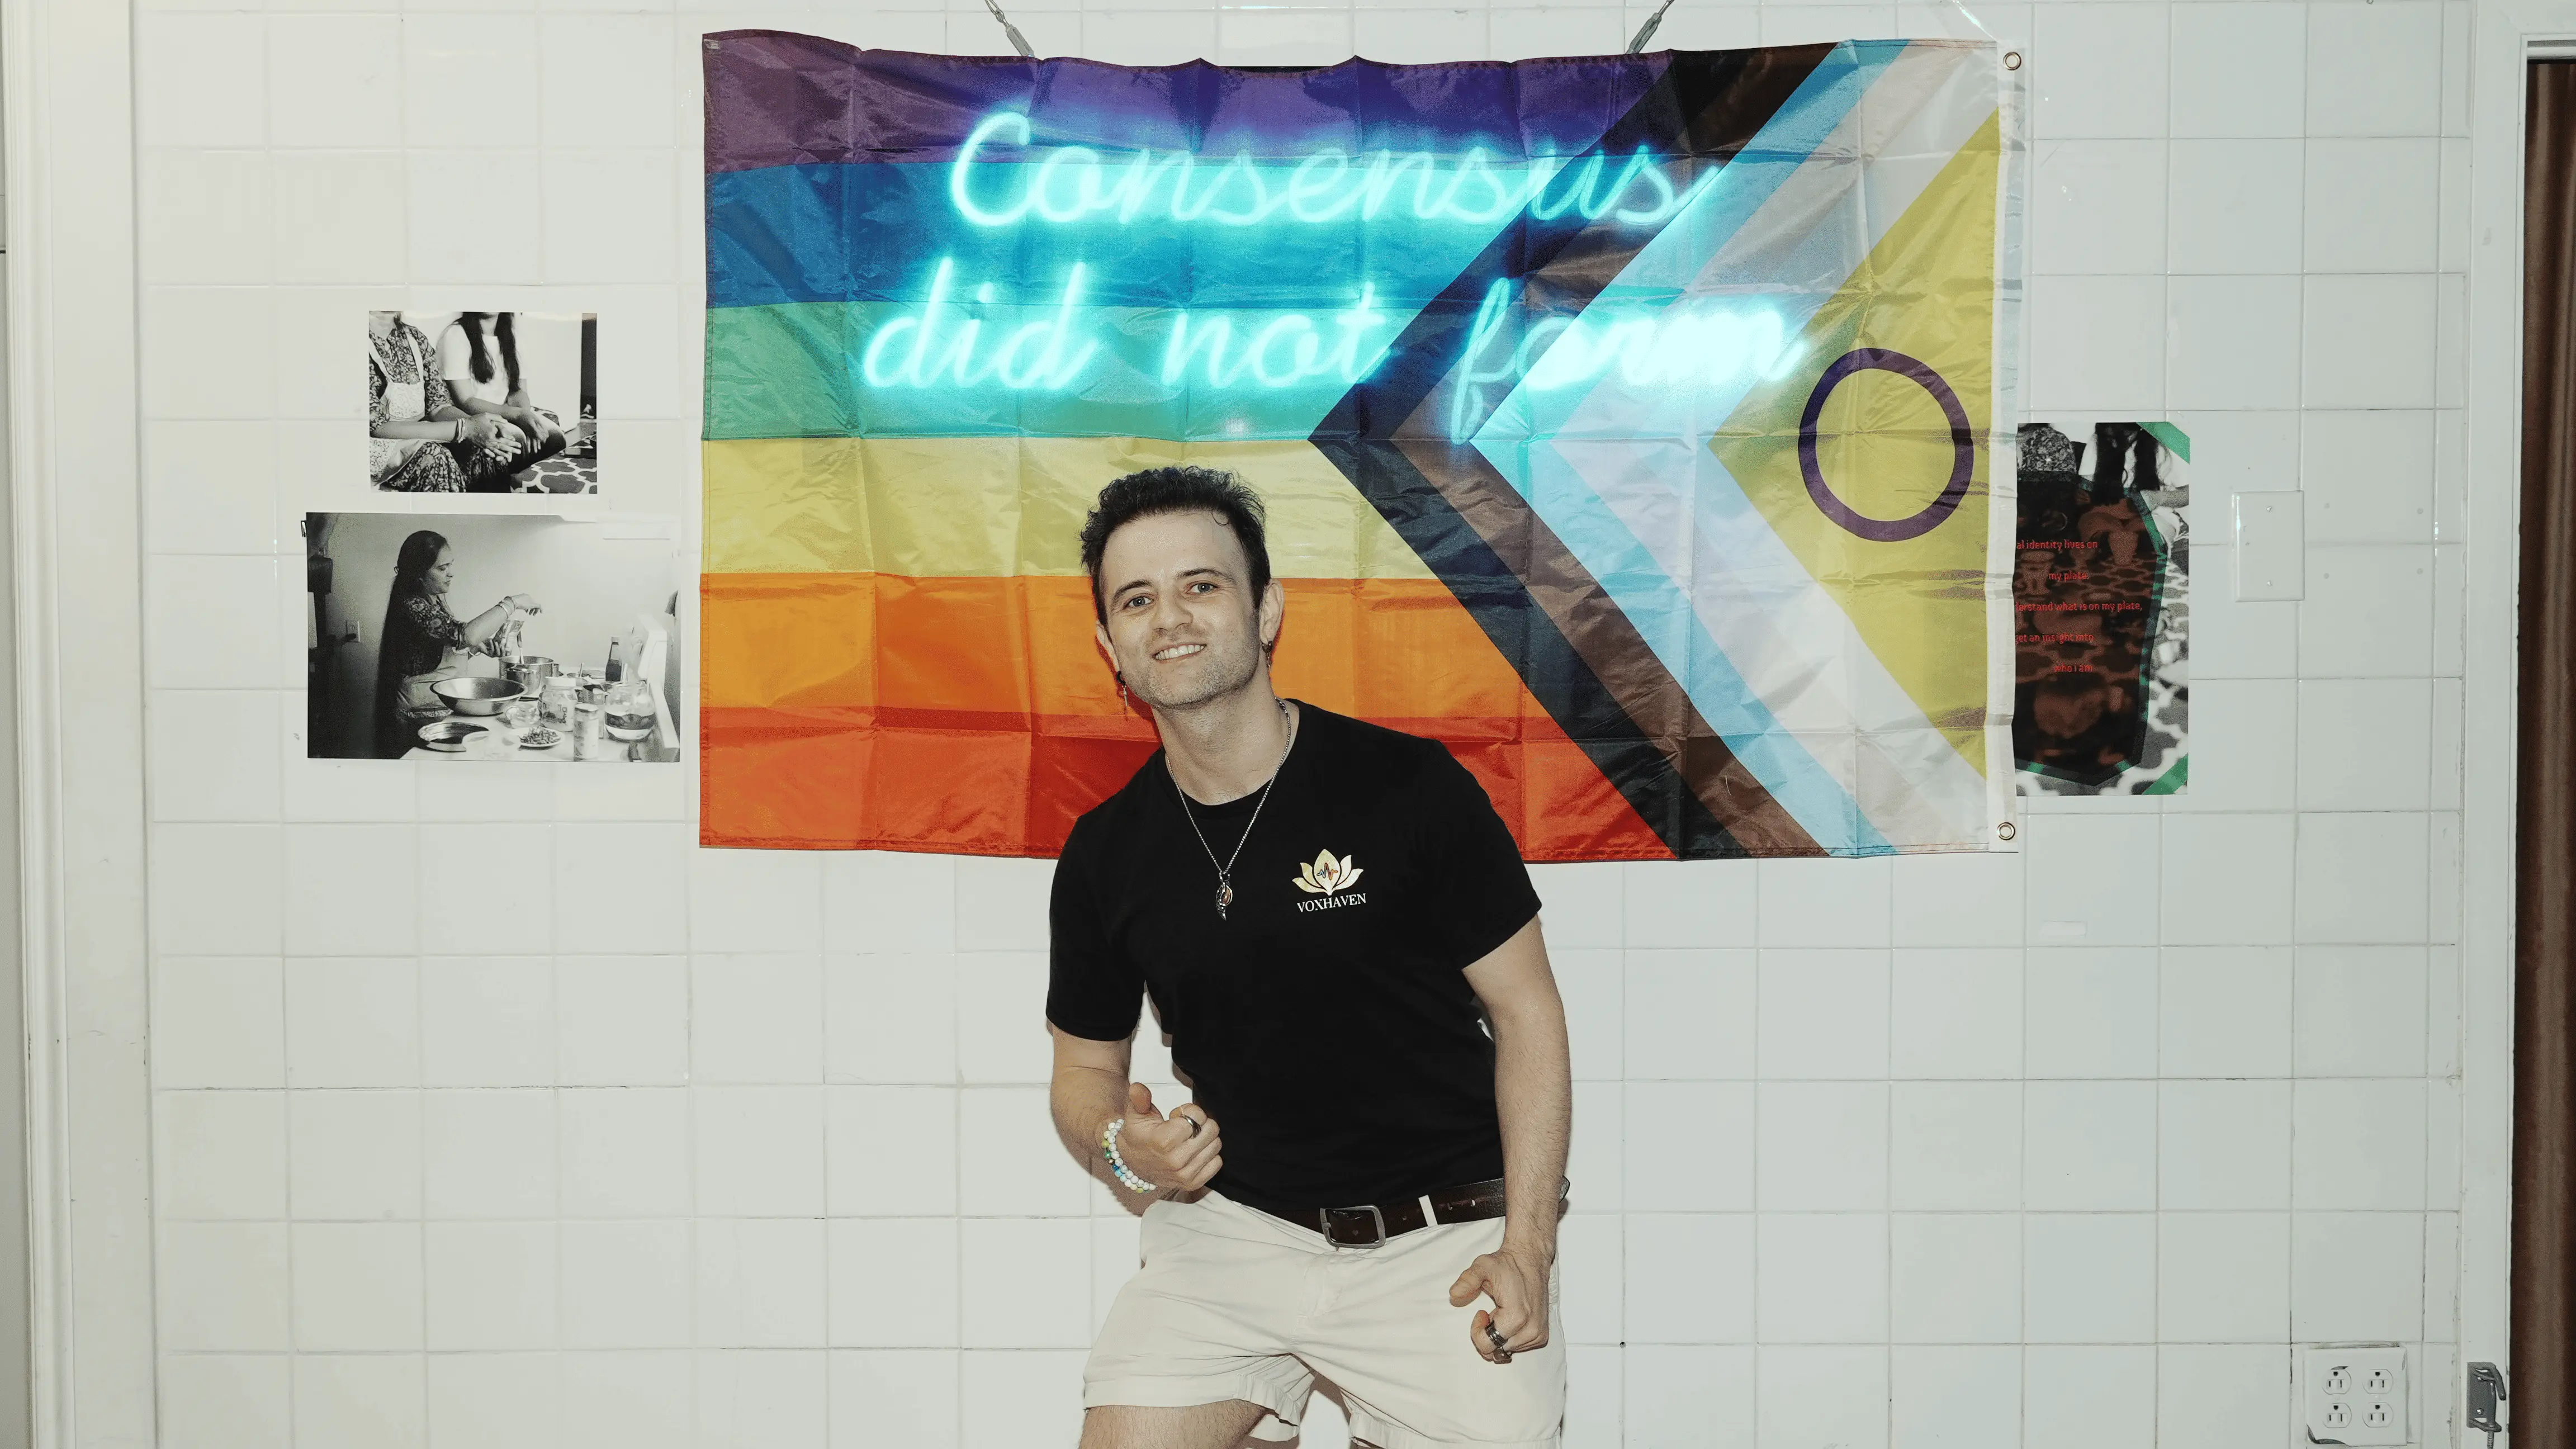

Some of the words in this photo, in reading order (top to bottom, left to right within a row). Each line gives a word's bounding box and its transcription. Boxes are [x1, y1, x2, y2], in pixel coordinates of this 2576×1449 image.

[950, 111, 1723, 226] Consensus
[863, 255, 1100, 390] did
[1159, 278, 1391, 390] not
[1450, 276, 1811, 446] form
[2026, 539, 2062, 551] identity
[2064, 539, 2085, 548] lives
[2048, 572, 2062, 582] my
[2055, 602, 2077, 611] what
[2079, 602, 2087, 611] is
[2101, 603, 2115, 613] my
[2117, 601, 2143, 613] plate,
[2042, 632, 2075, 644] insight
[2076, 632, 2095, 642] into
[2053, 662, 2072, 672] who
[1297, 893, 1366, 912] VOXHAVEN
